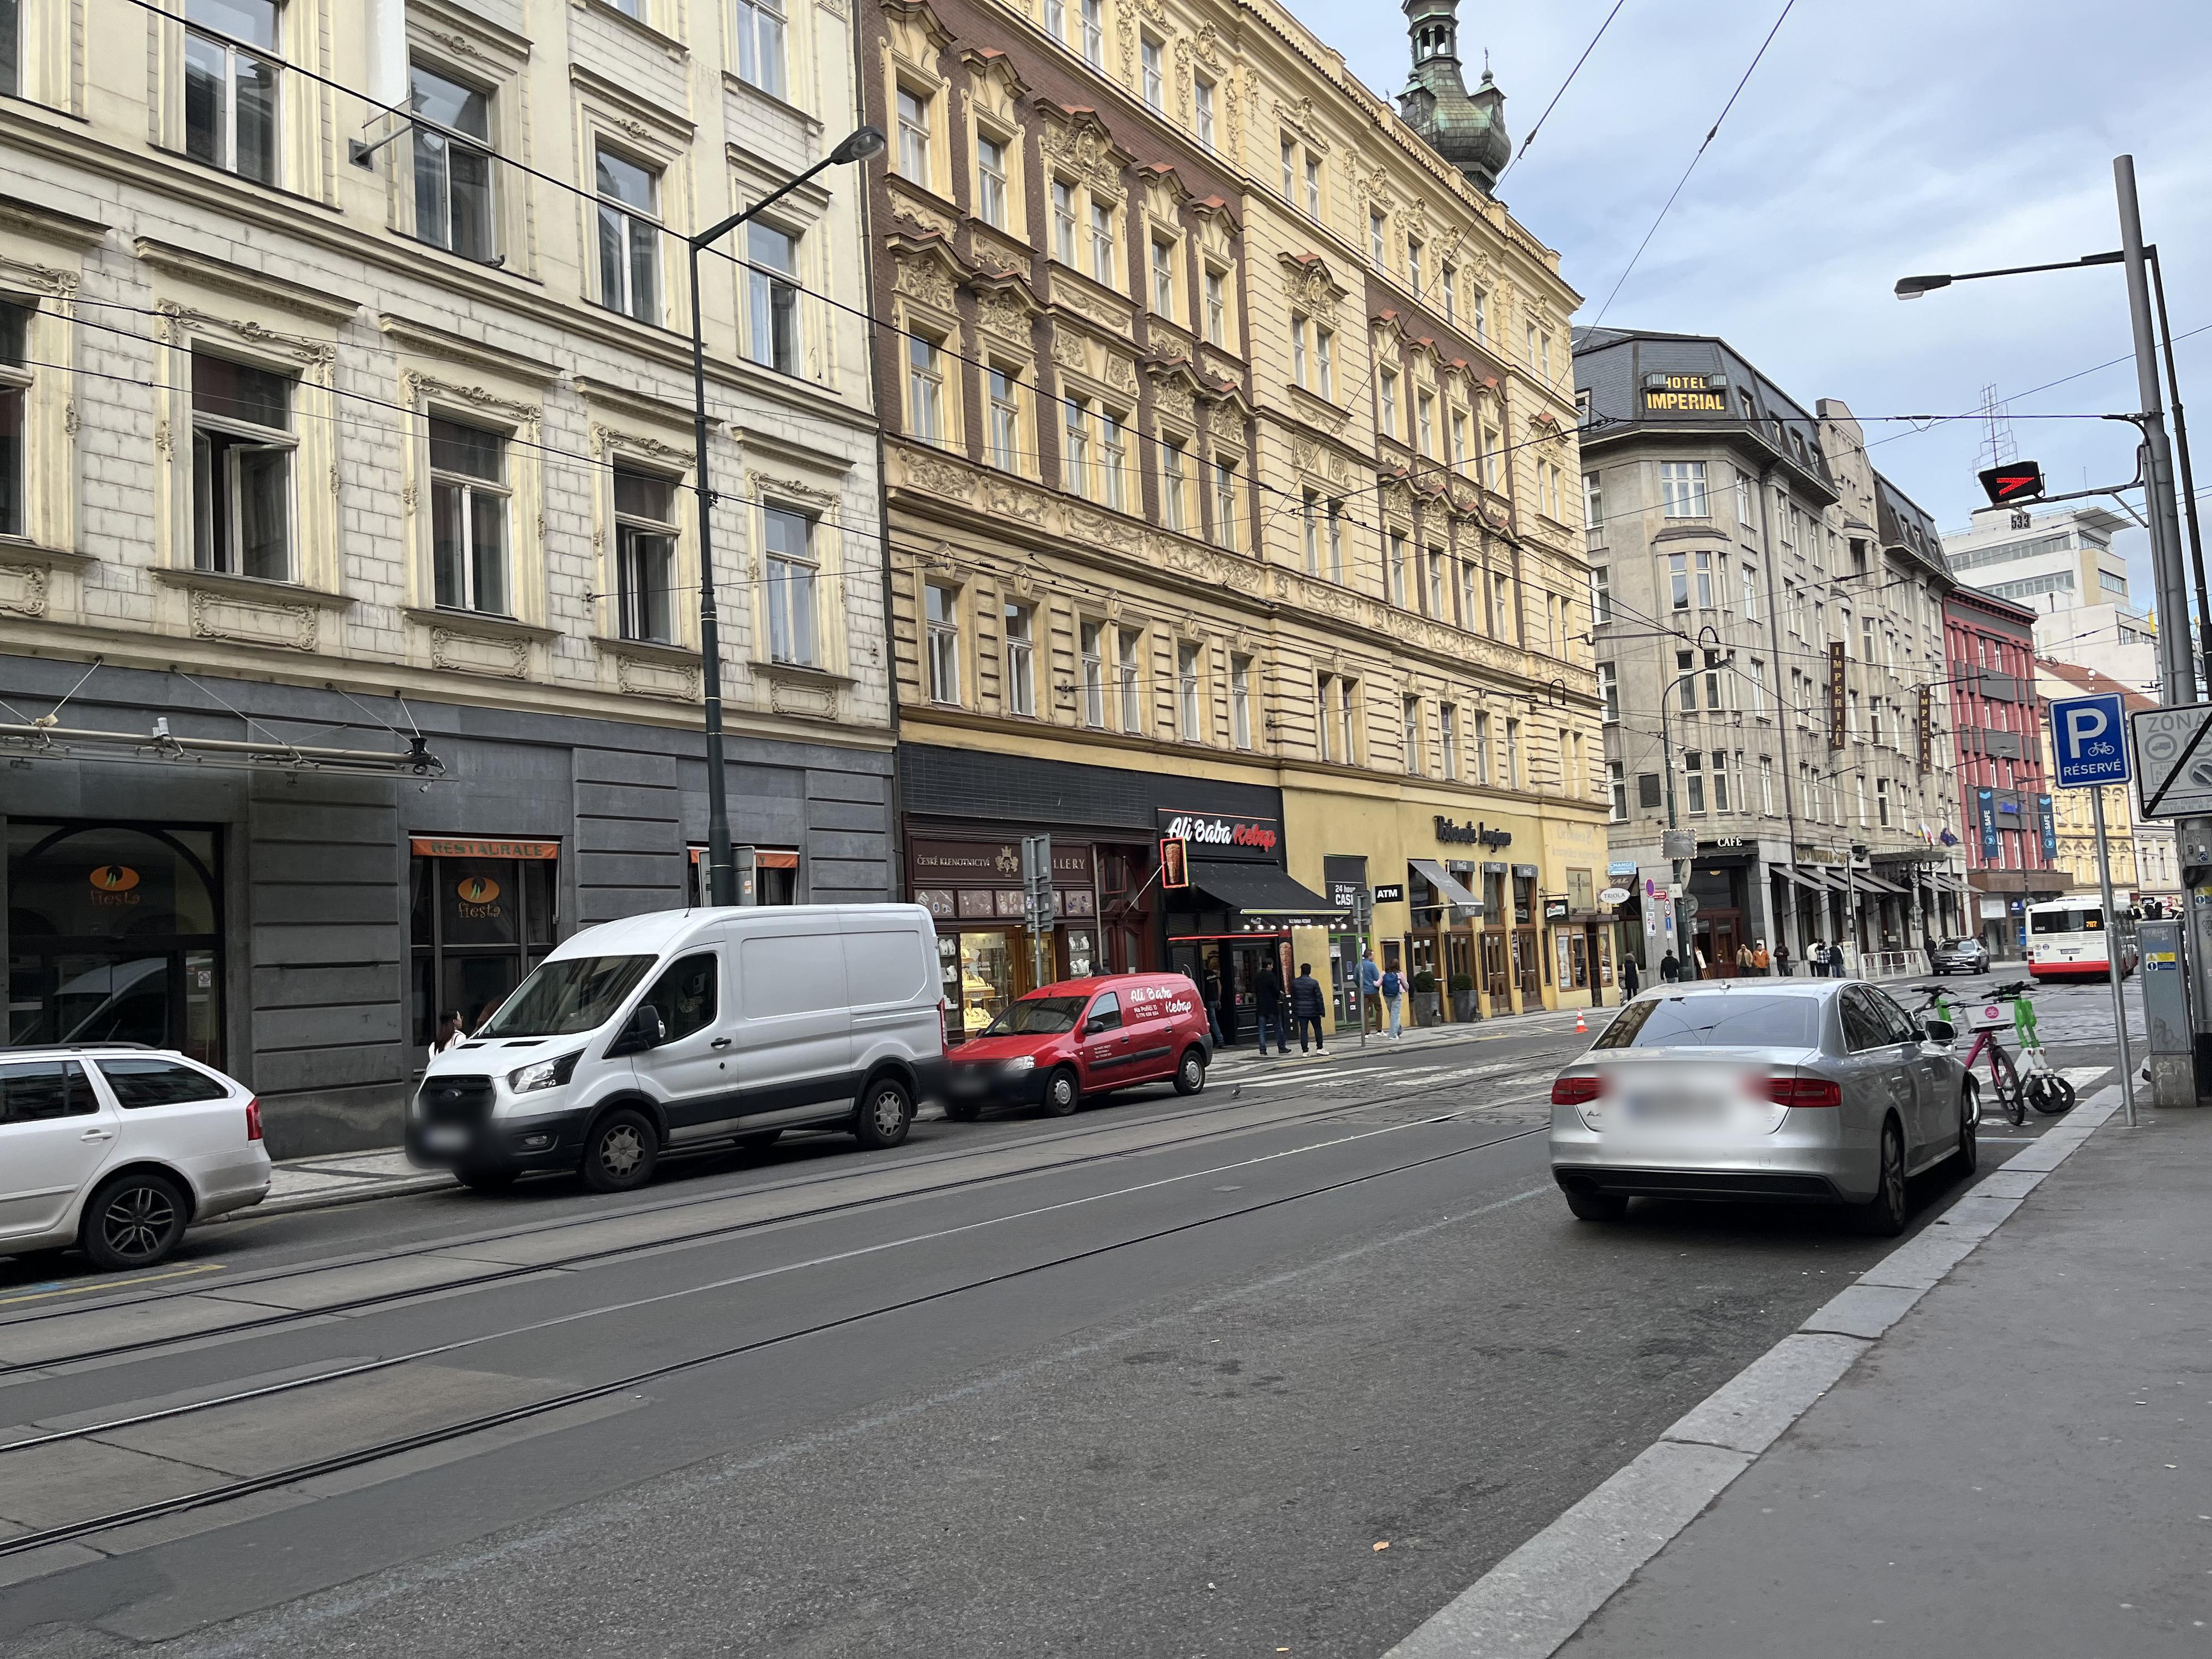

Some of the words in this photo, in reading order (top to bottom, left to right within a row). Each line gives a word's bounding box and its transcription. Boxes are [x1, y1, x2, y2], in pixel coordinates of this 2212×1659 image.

[1666, 377, 1707, 389] HOTEL
[1647, 393, 1725, 410] IMPERIAL
[2011, 514, 2030, 529] 533
[1833, 646, 1843, 745] IMPERIAL
[2146, 710, 2208, 733] ZÓNA
[1921, 691, 1929, 771] IMPERIAL
[2066, 708, 2107, 759] P
[2063, 758, 2122, 776] RÉSERVÉ
[1983, 810, 1992, 833] 24SAFE
[2043, 814, 2052, 837] 24SAFE
[1166, 816, 1193, 842] Ali
[1194, 818, 1232, 844] Baba
[1233, 823, 1277, 853] Kebap
[1717, 836, 1743, 847] CAFÉ
[431, 842, 543, 857] RESTAURACE
[917, 854, 938, 866] ČESKÉ
[940, 857, 990, 868] KLENOTNICTVÍ
[1053, 858, 1085, 870] LLERY
[1335, 884, 1343, 893] 24
[1377, 889, 1398, 898] ATM
[459, 901, 500, 919] fiesta
[1130, 988, 1145, 1003] Ali
[1146, 986, 1173, 1000] Baba
[1165, 999, 1192, 1013] Kebap
